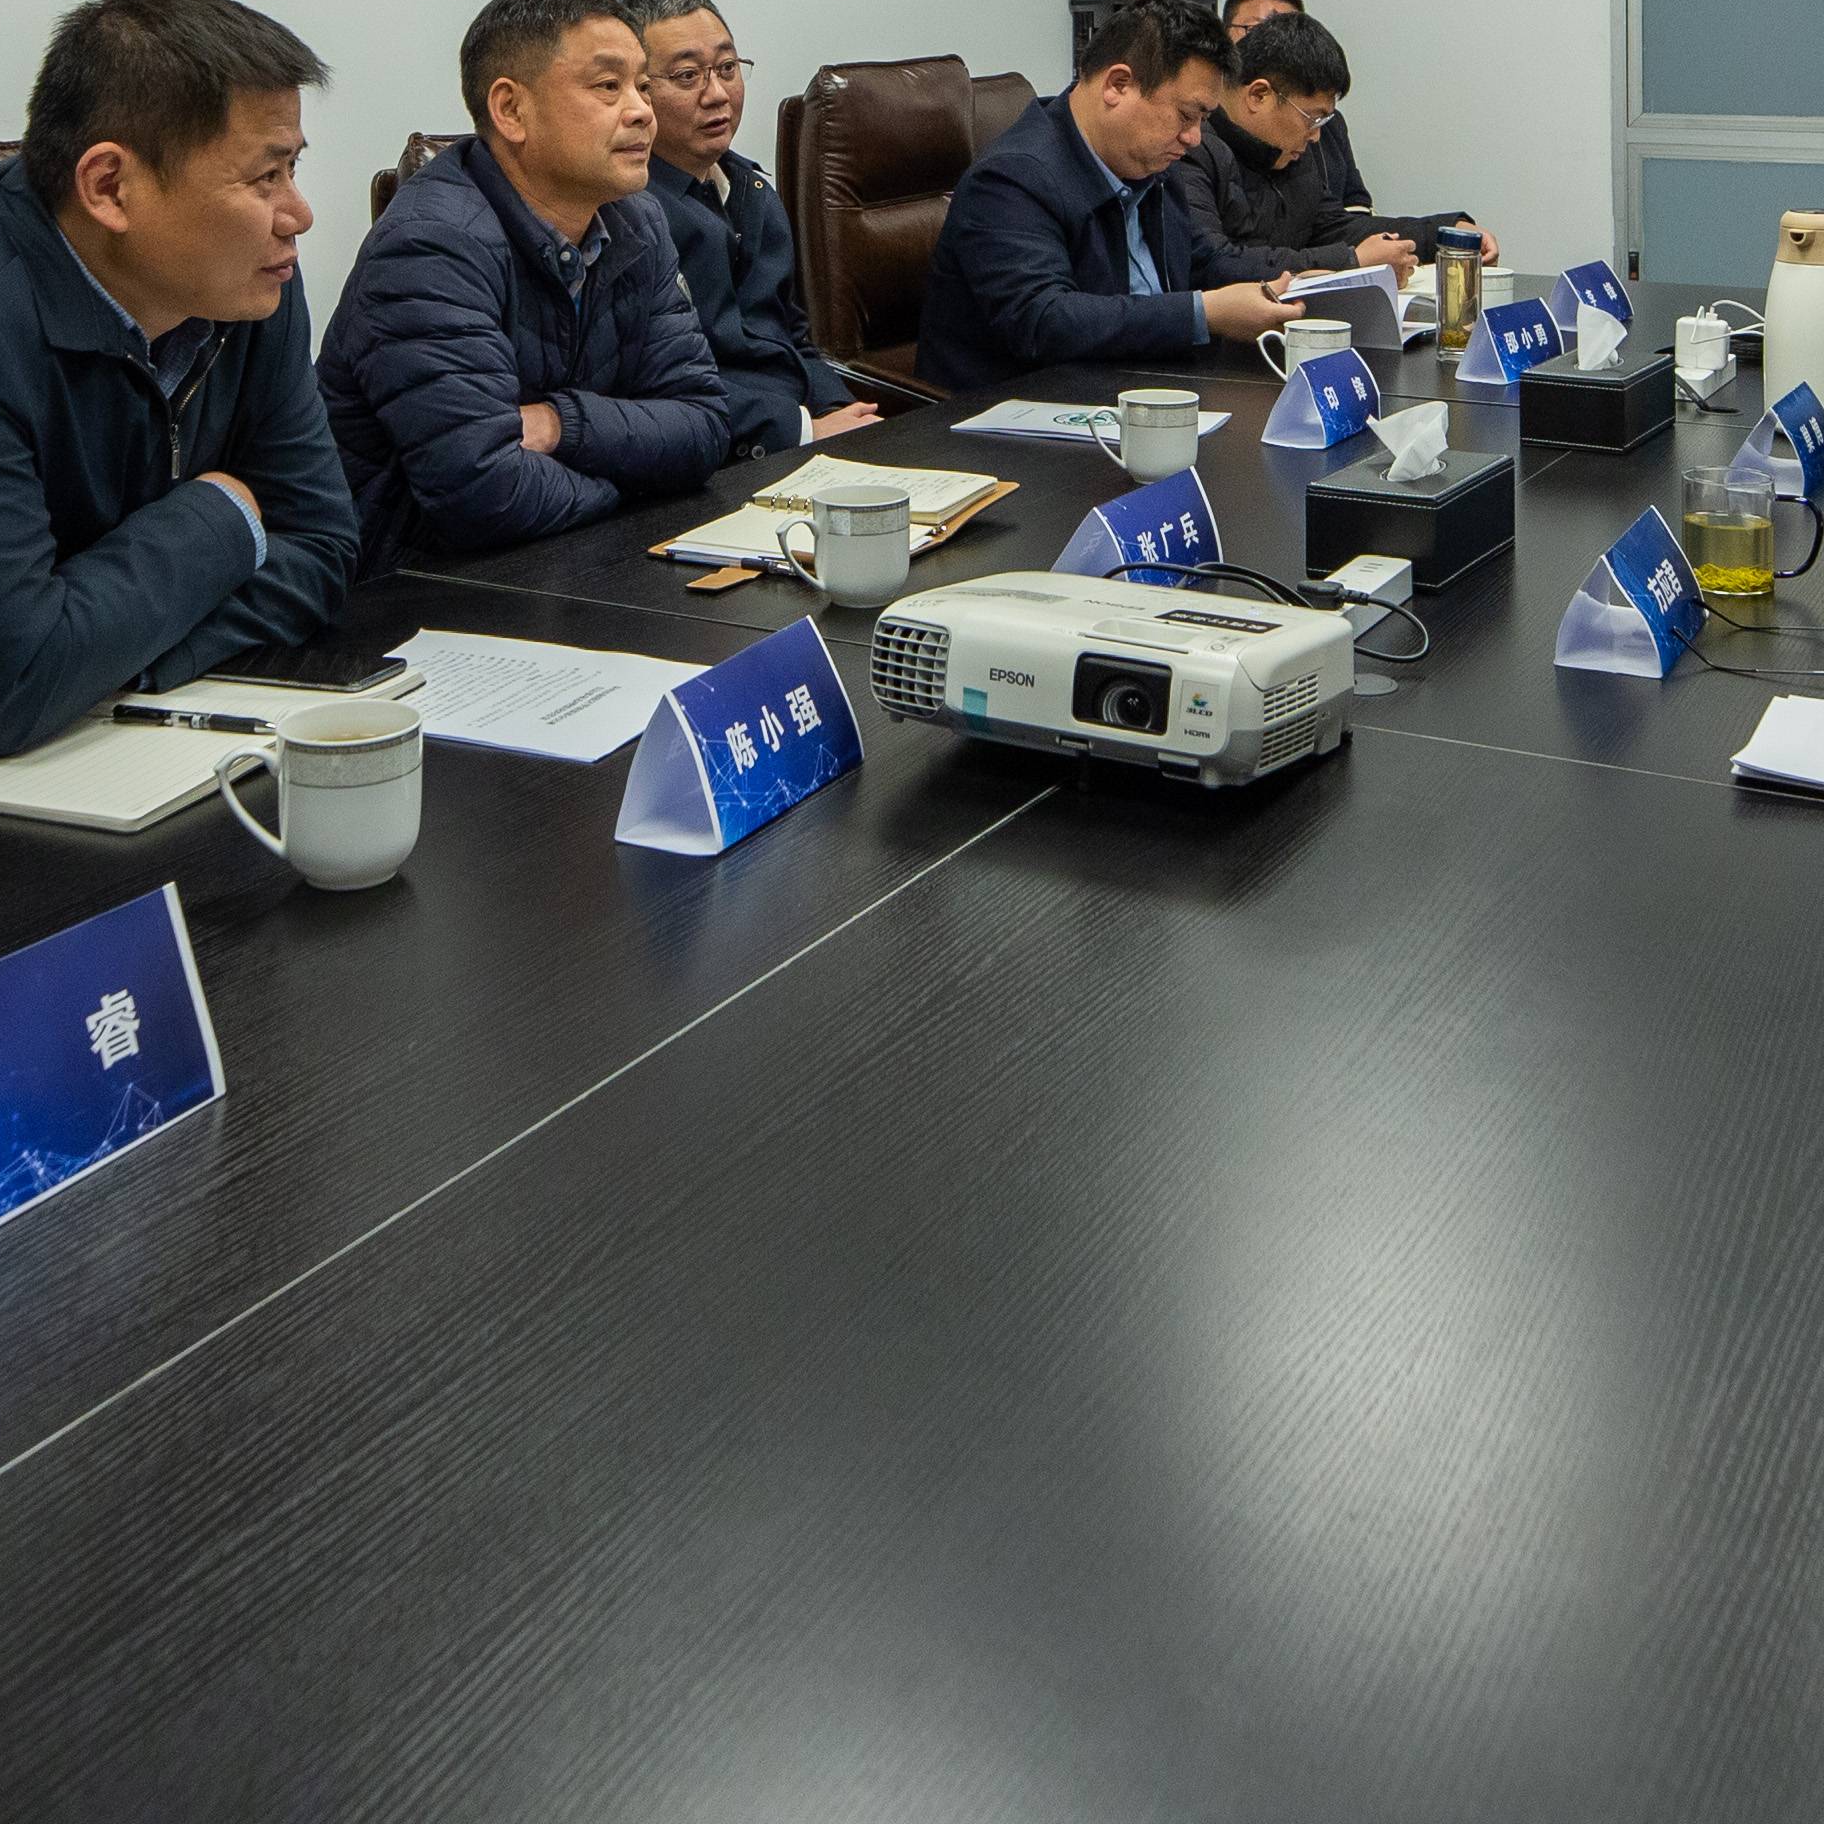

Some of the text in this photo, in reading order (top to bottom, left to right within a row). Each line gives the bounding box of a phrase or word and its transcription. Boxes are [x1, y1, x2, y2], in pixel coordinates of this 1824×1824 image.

[1504, 324, 1548, 354] 邵小勇
[1137, 512, 1199, 563] 张广兵
[1647, 559, 1683, 615] 方应君
[989, 667, 1036, 689] EPSON
[725, 684, 822, 775] 陈小强
[1184, 729, 1210, 739] HDMI
